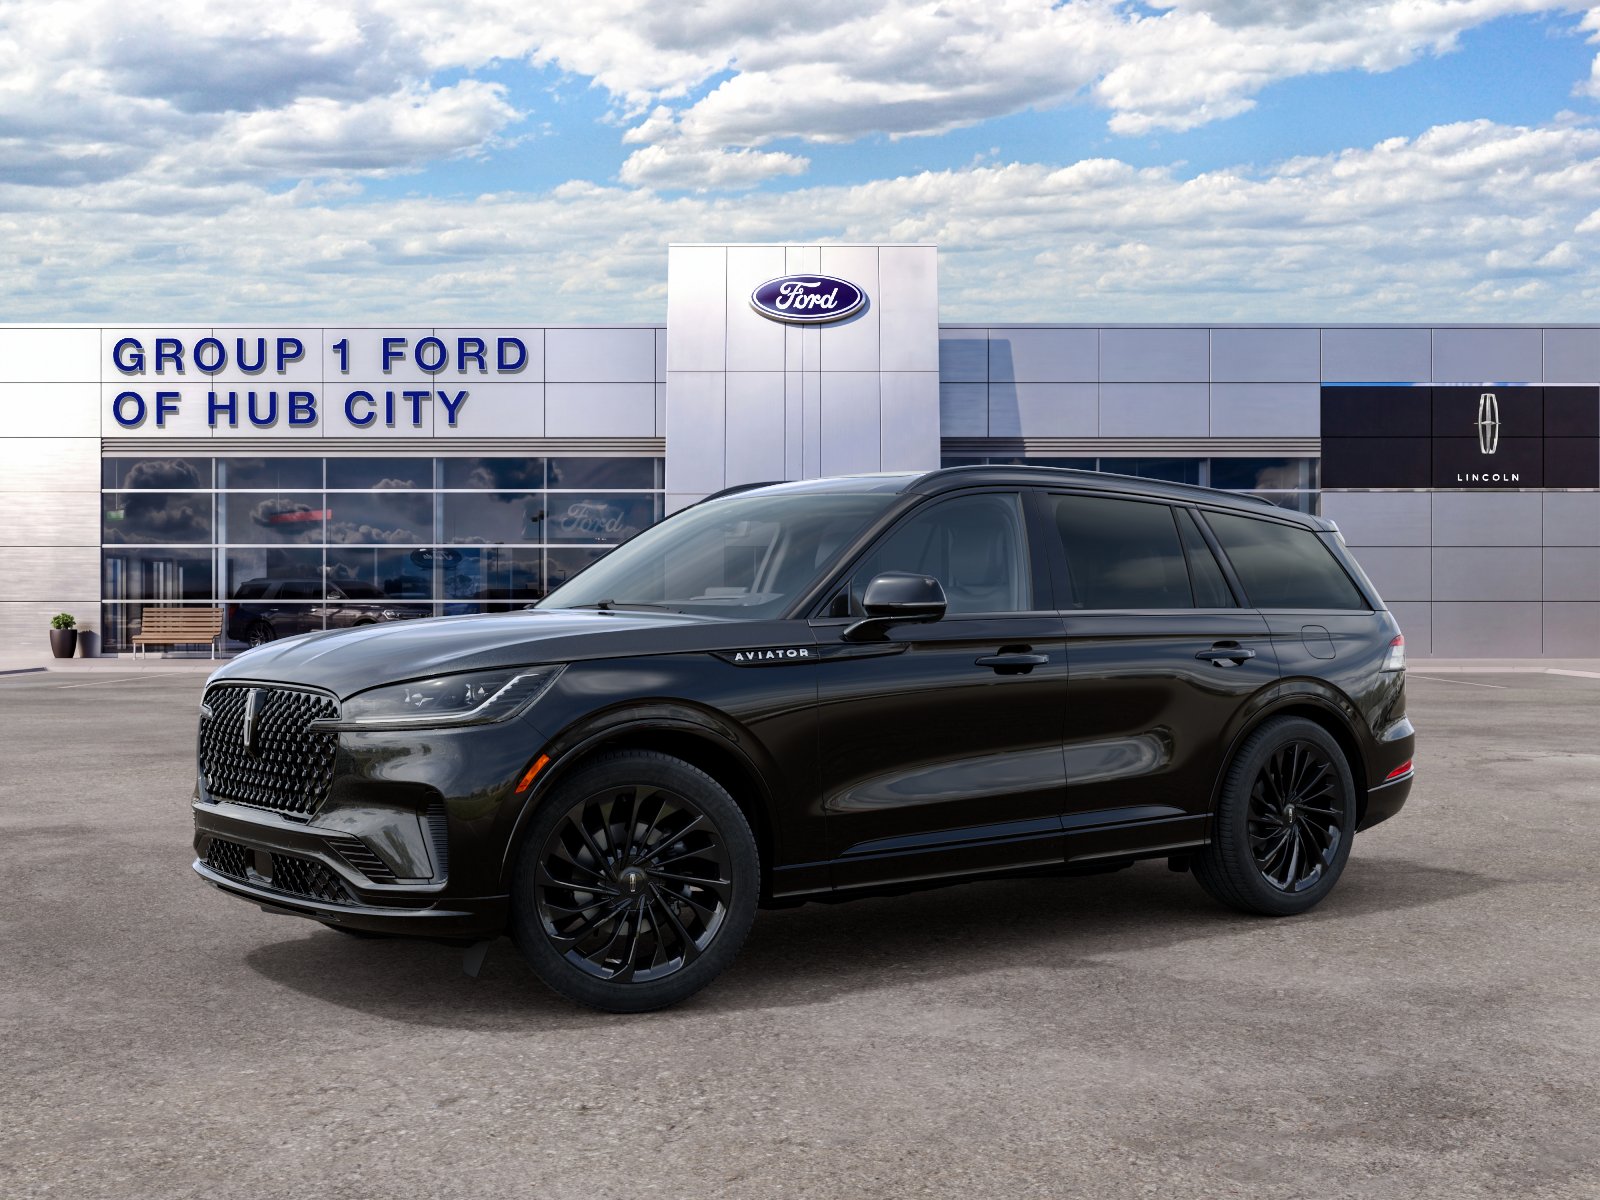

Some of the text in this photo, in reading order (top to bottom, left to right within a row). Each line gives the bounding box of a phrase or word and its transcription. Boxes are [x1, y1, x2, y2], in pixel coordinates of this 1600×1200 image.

[775, 281, 839, 310] Ford
[112, 336, 528, 373] GROUP 1 FORD
[112, 390, 468, 427] OF HUB CITY
[1457, 473, 1520, 482] LINCOLN
[561, 502, 624, 532] Ford
[734, 648, 809, 661] AVIATOR
